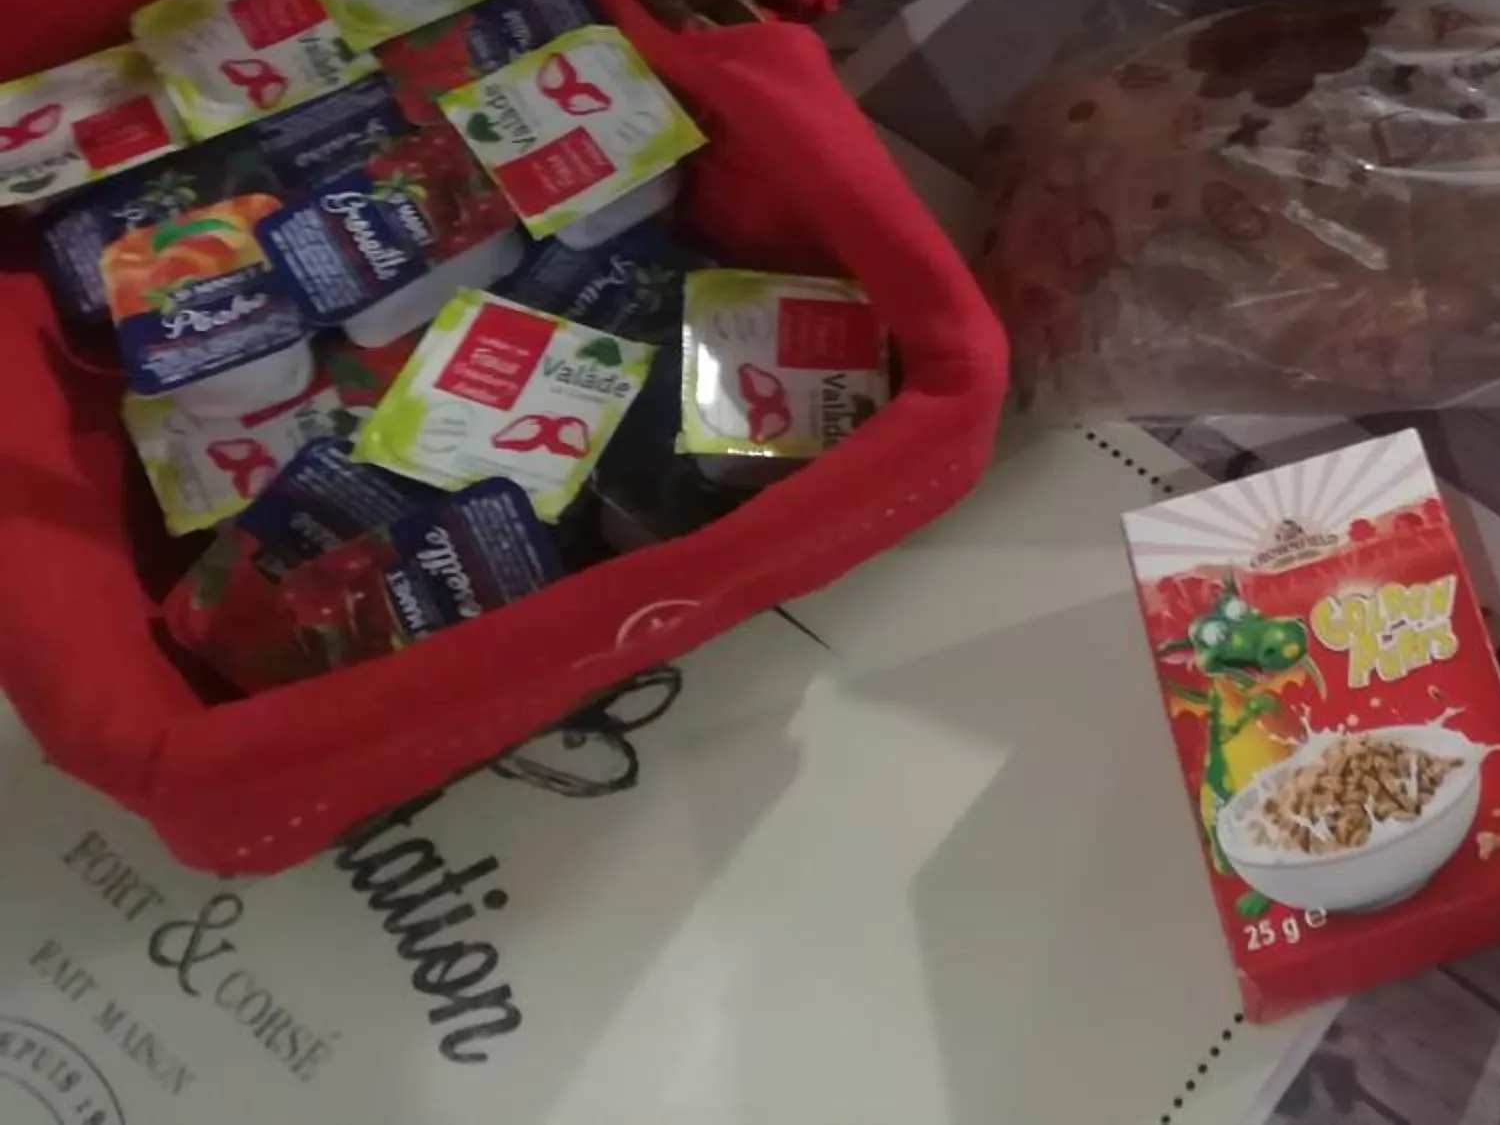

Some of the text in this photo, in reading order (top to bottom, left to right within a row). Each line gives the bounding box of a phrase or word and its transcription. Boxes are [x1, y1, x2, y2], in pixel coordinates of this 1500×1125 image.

[542, 352, 633, 400] Valade
[415, 525, 483, 618] oseille
[61, 829, 345, 1084] FORT & CORSÉ
[1243, 919, 1277, 950] 25
